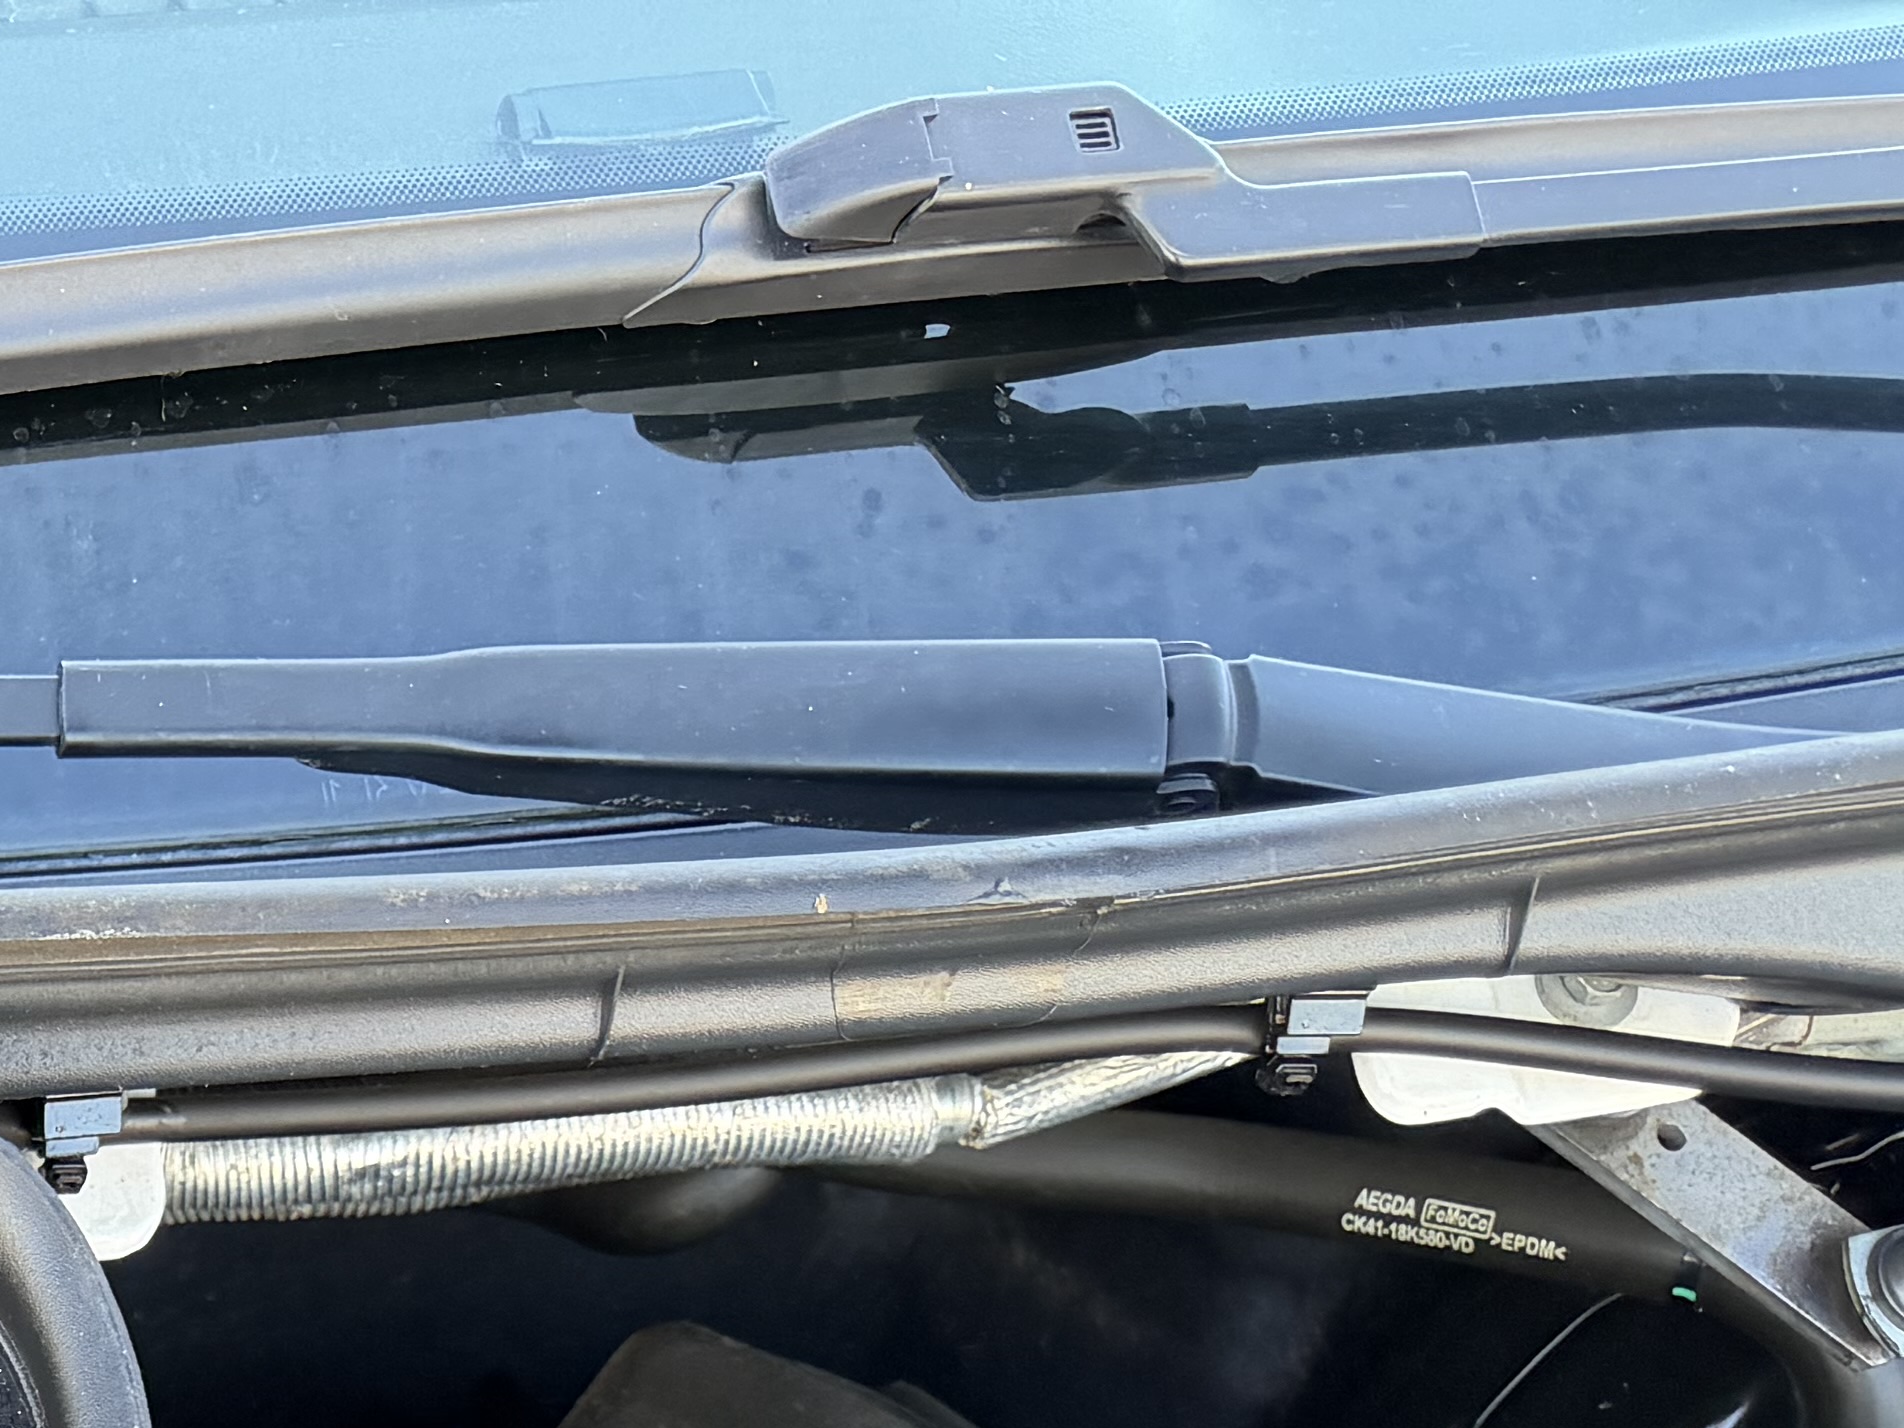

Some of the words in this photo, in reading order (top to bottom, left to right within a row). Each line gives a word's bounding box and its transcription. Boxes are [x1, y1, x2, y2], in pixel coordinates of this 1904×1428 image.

[1354, 1187, 1416, 1219] AEGDA
[1426, 1204, 1489, 1231] FoMoCo
[1490, 1232, 1568, 1261] >EPDM<
